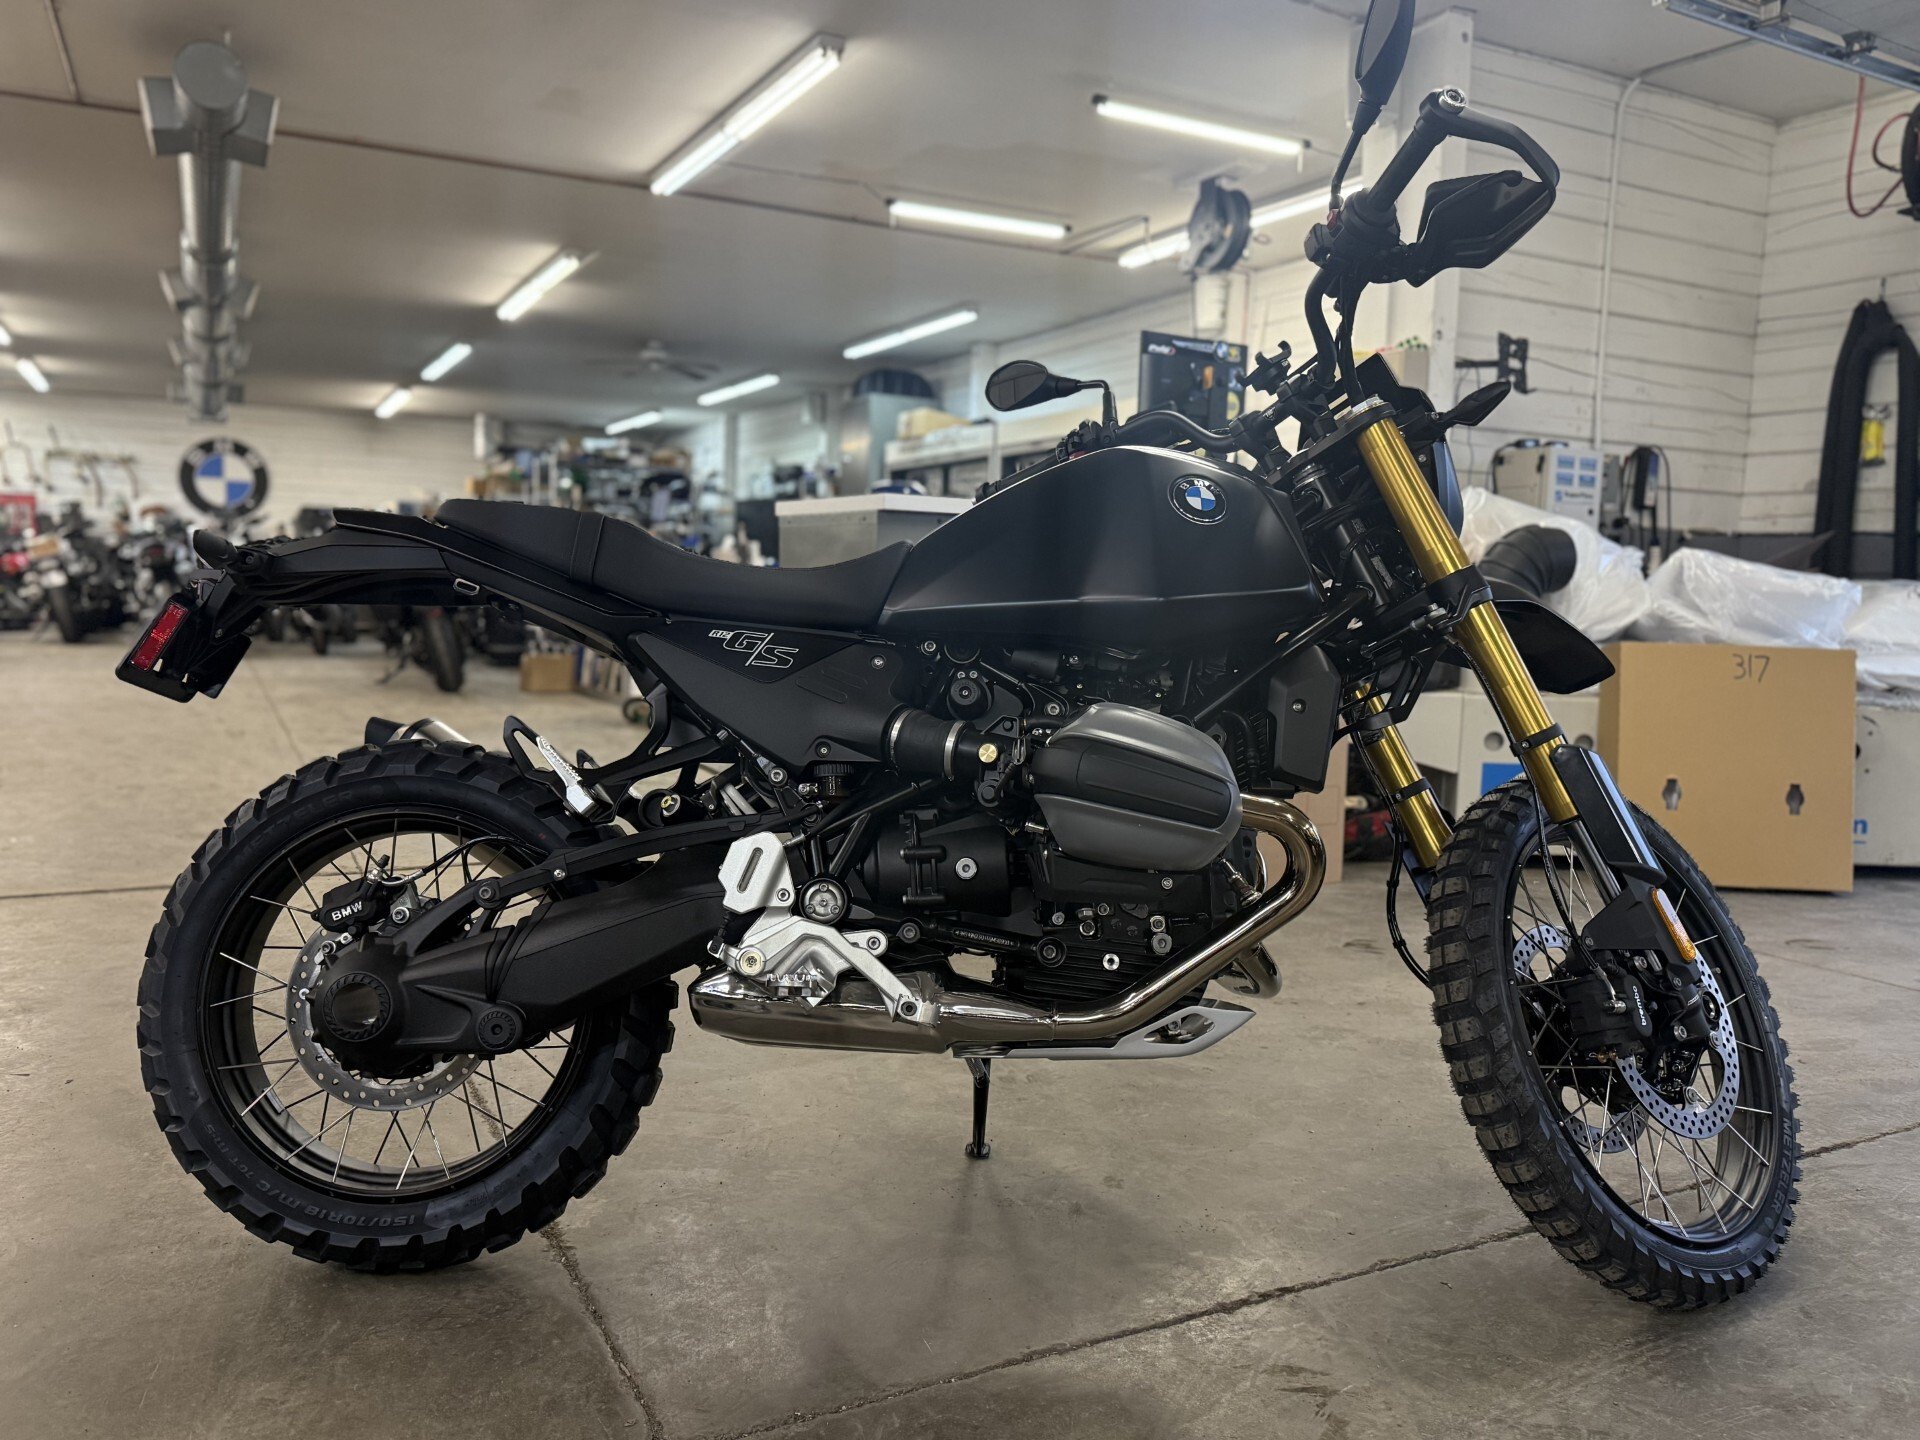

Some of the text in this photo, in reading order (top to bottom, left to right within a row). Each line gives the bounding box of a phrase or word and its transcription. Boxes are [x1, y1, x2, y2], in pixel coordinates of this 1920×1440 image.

[1179, 479, 1221, 494] BMW
[1732, 653, 1770, 683] 317
[331, 900, 363, 922] BMW
[1632, 985, 1647, 1026] brembo
[1771, 1117, 1793, 1215] METZELER
[304, 1206, 416, 1228] 150/70R18
